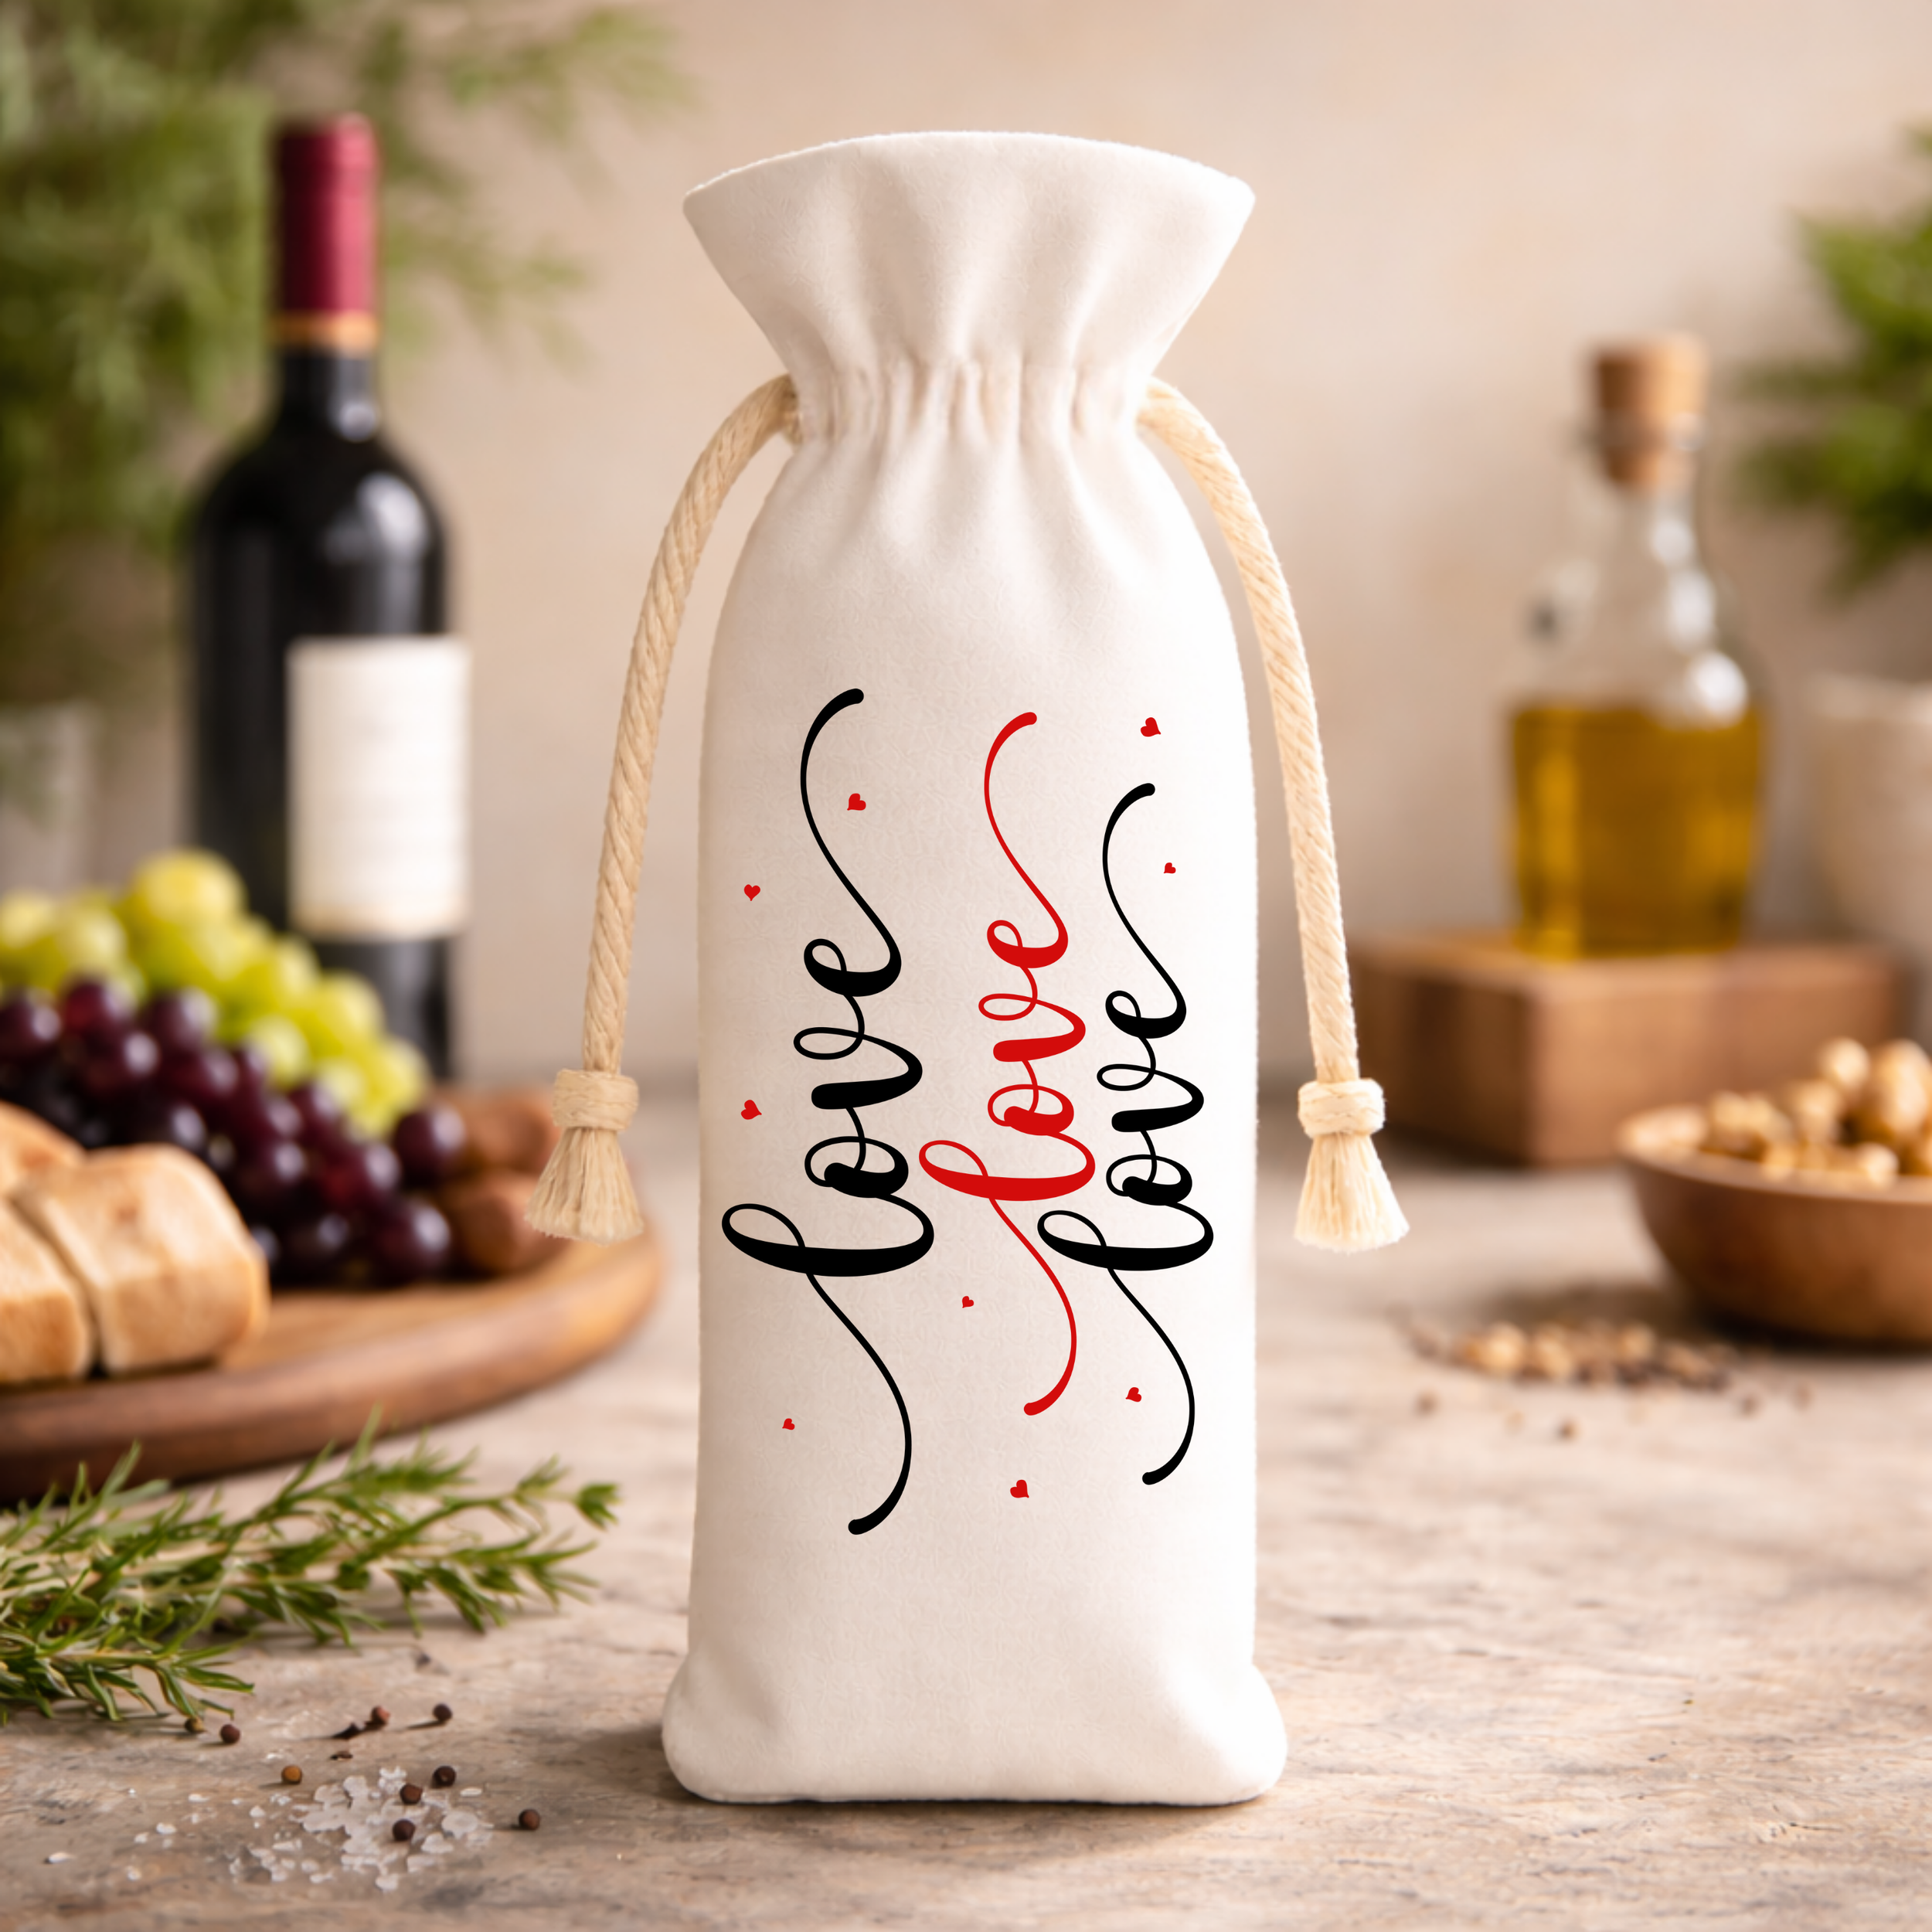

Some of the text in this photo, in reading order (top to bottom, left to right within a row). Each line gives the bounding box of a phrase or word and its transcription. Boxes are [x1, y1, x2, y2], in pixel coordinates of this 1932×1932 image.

[721, 688, 935, 1536] love
[918, 712, 1096, 1417] love
[1036, 782, 1214, 1485] love
